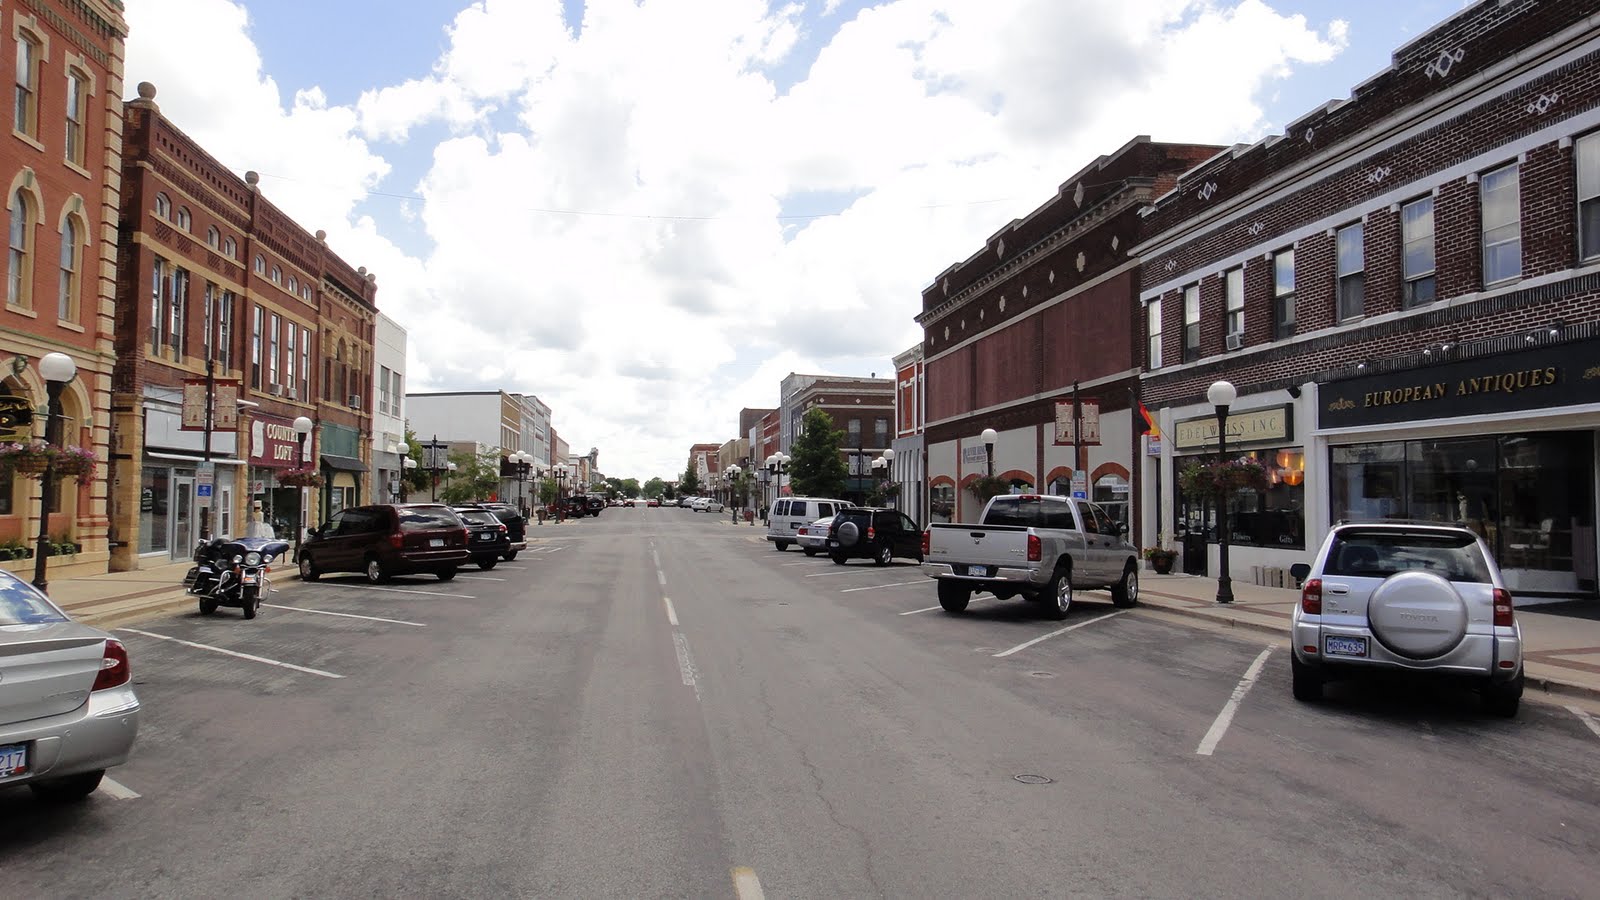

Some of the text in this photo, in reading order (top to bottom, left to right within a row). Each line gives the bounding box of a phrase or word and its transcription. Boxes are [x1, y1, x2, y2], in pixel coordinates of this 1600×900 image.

[1365, 367, 1557, 408] EUROPEAN ANTIQUES
[274, 444, 293, 461] LOFT
[1399, 612, 1440, 623] TOYOTA
